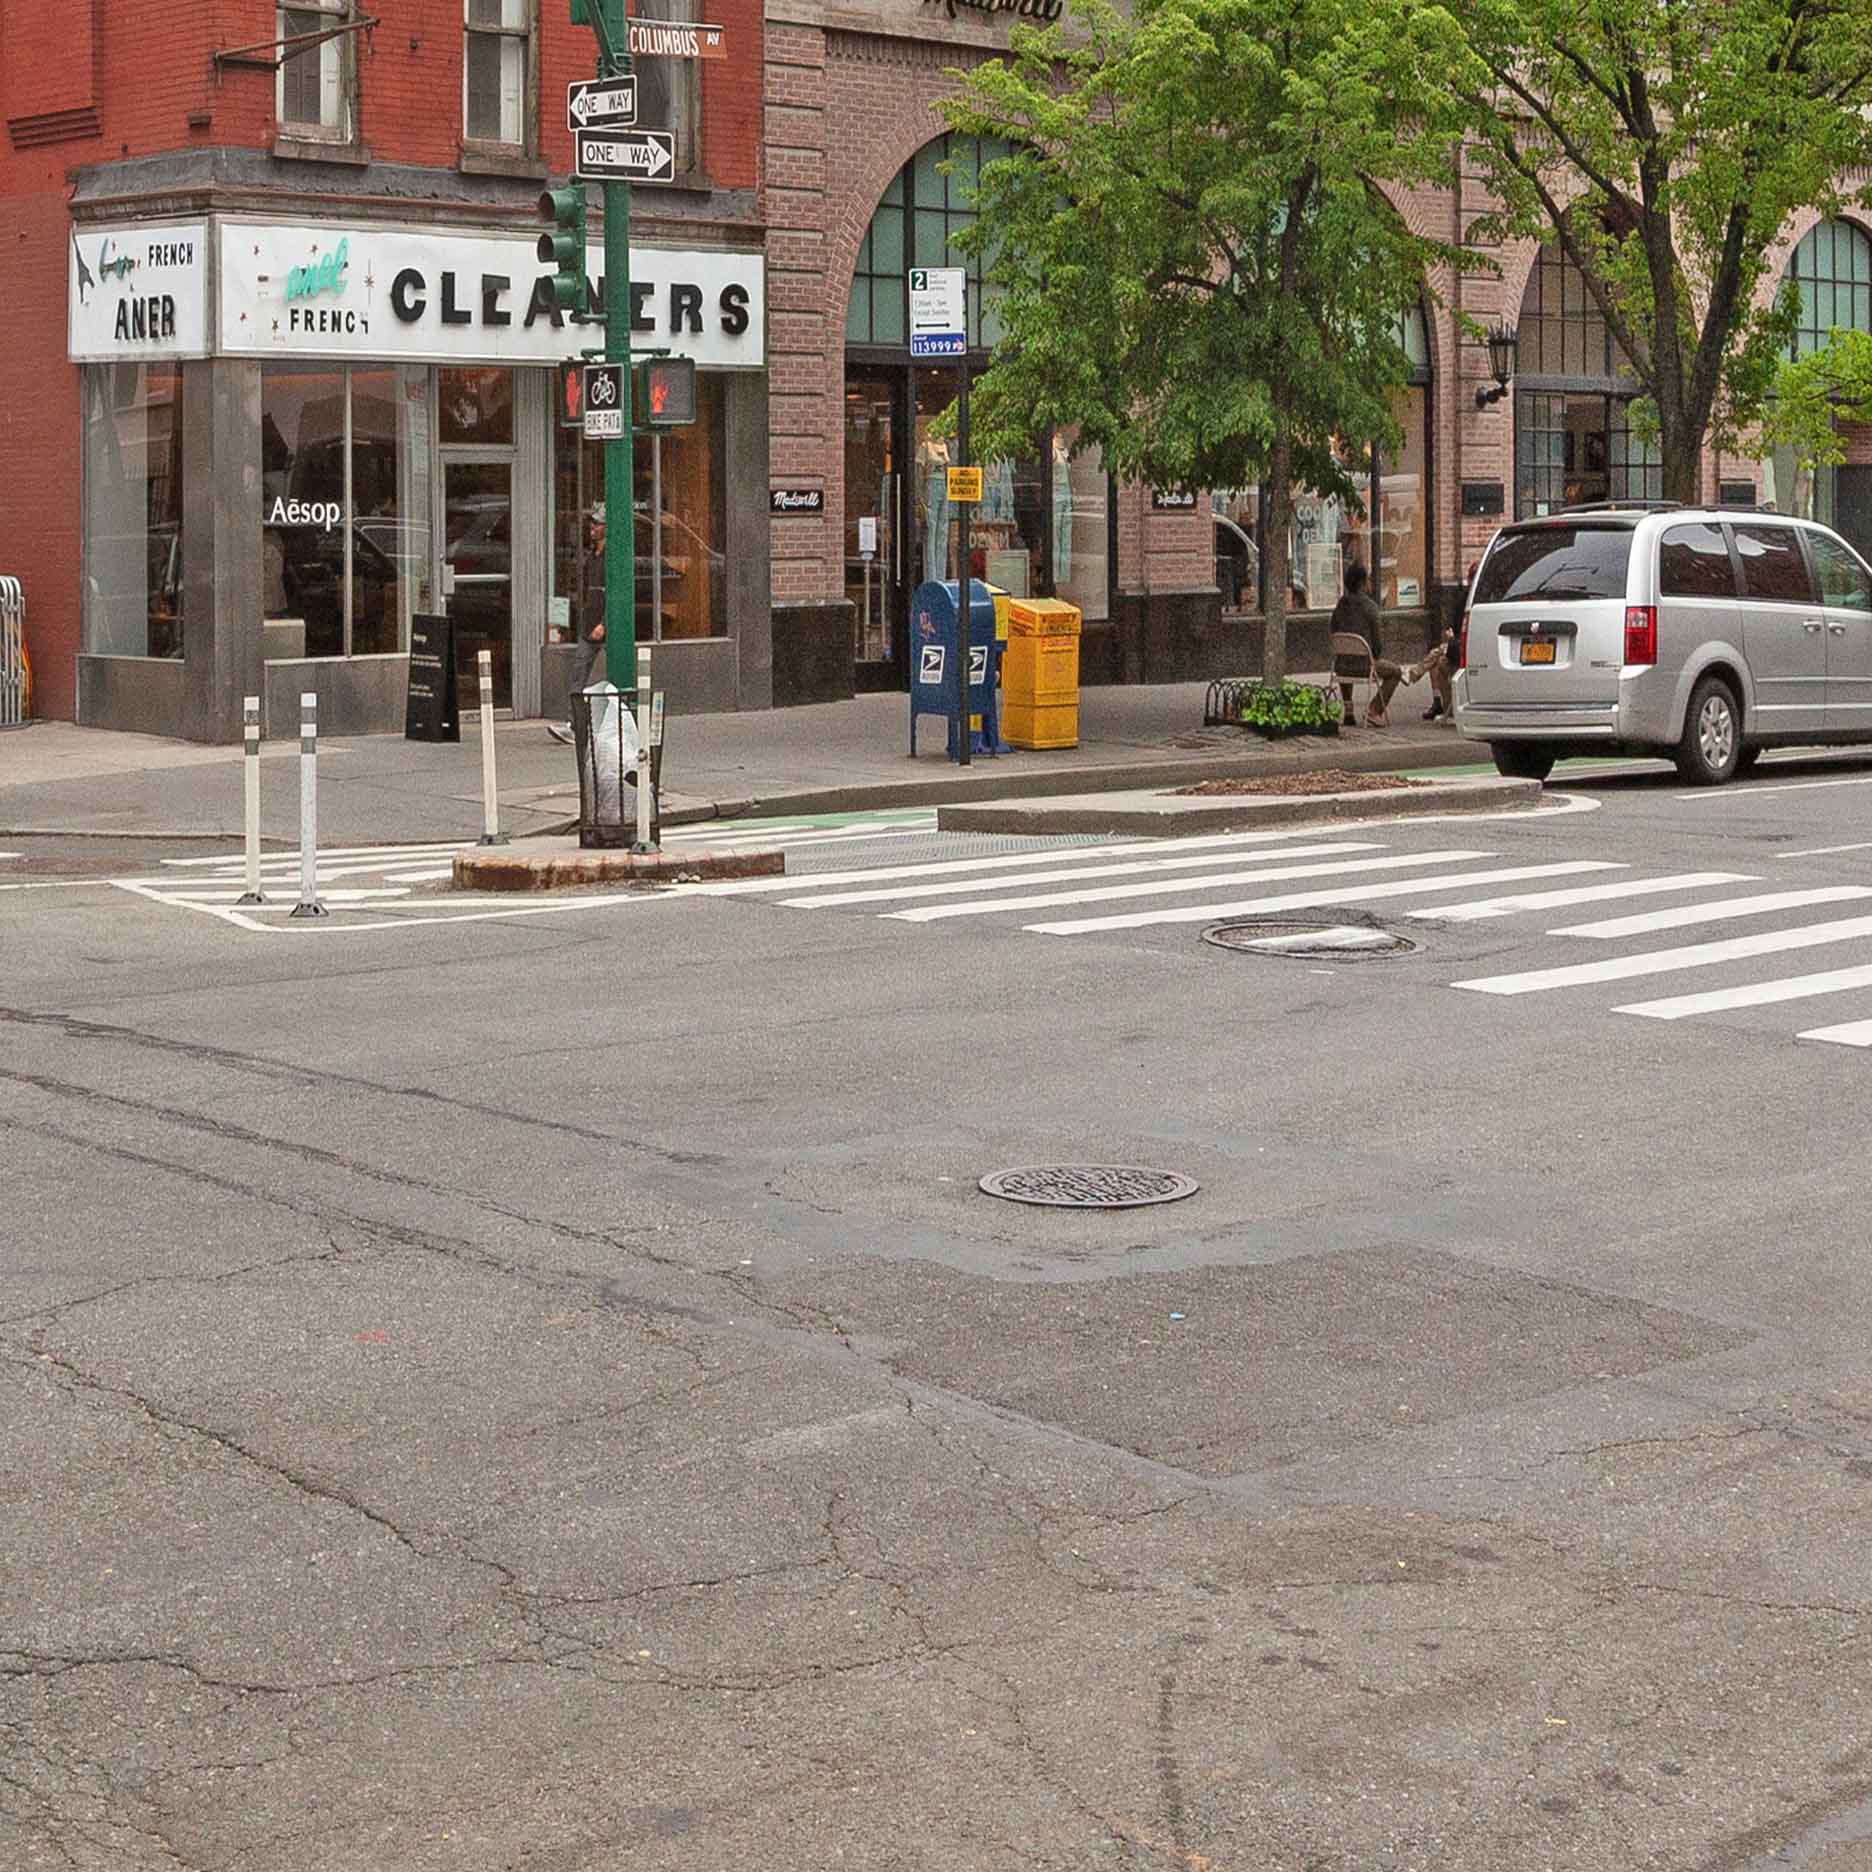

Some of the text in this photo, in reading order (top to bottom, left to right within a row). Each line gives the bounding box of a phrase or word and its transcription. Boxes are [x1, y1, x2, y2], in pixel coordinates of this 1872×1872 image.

[630, 27, 720, 56] COLUMBUS AV
[578, 92, 629, 114] ONE WAY
[586, 144, 660, 165] ONE WAY
[148, 242, 193, 267] FRENCH
[914, 272, 924, 289] 2
[587, 413, 601, 431] BIKE
[270, 495, 340, 532] Aēsop
